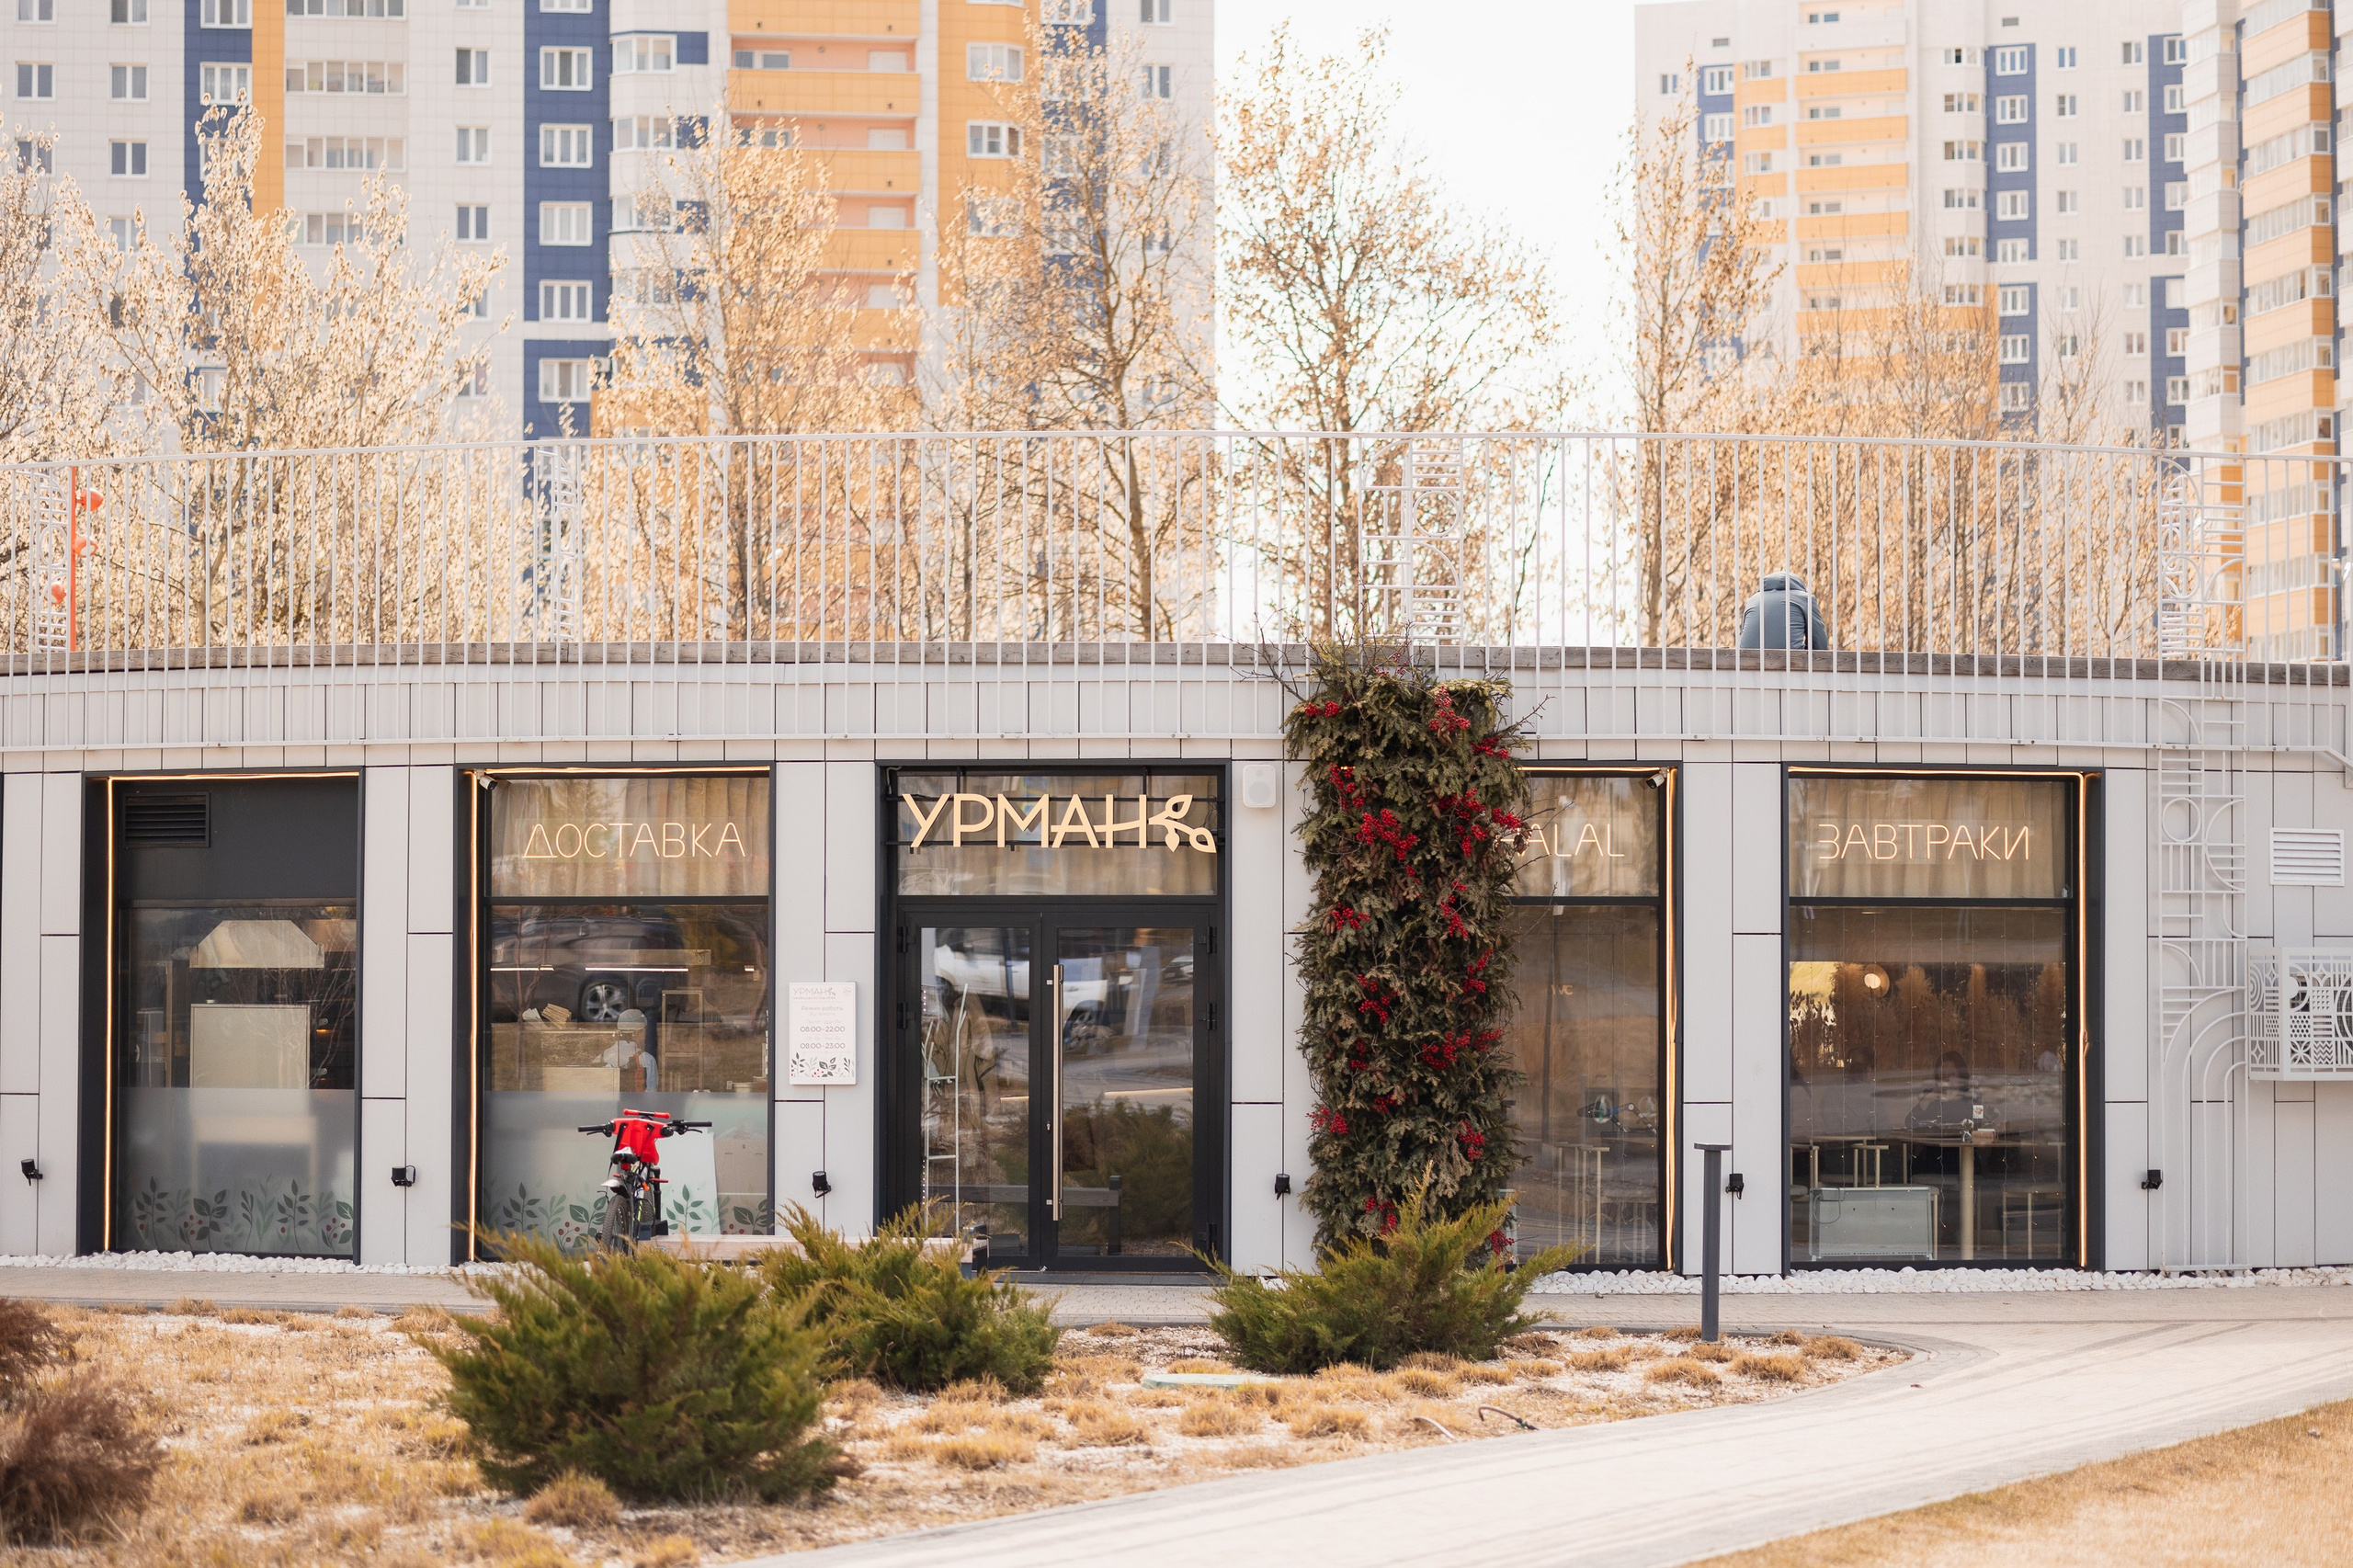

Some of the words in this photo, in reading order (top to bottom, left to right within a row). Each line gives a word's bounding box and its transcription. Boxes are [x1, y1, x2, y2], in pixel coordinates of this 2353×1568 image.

[902, 793, 1147, 848] УРМАН
[522, 822, 746, 858] ДОСТАВКА
[1818, 824, 2029, 860] ЗАВТРАКИ
[793, 987, 827, 995] УРМАН
